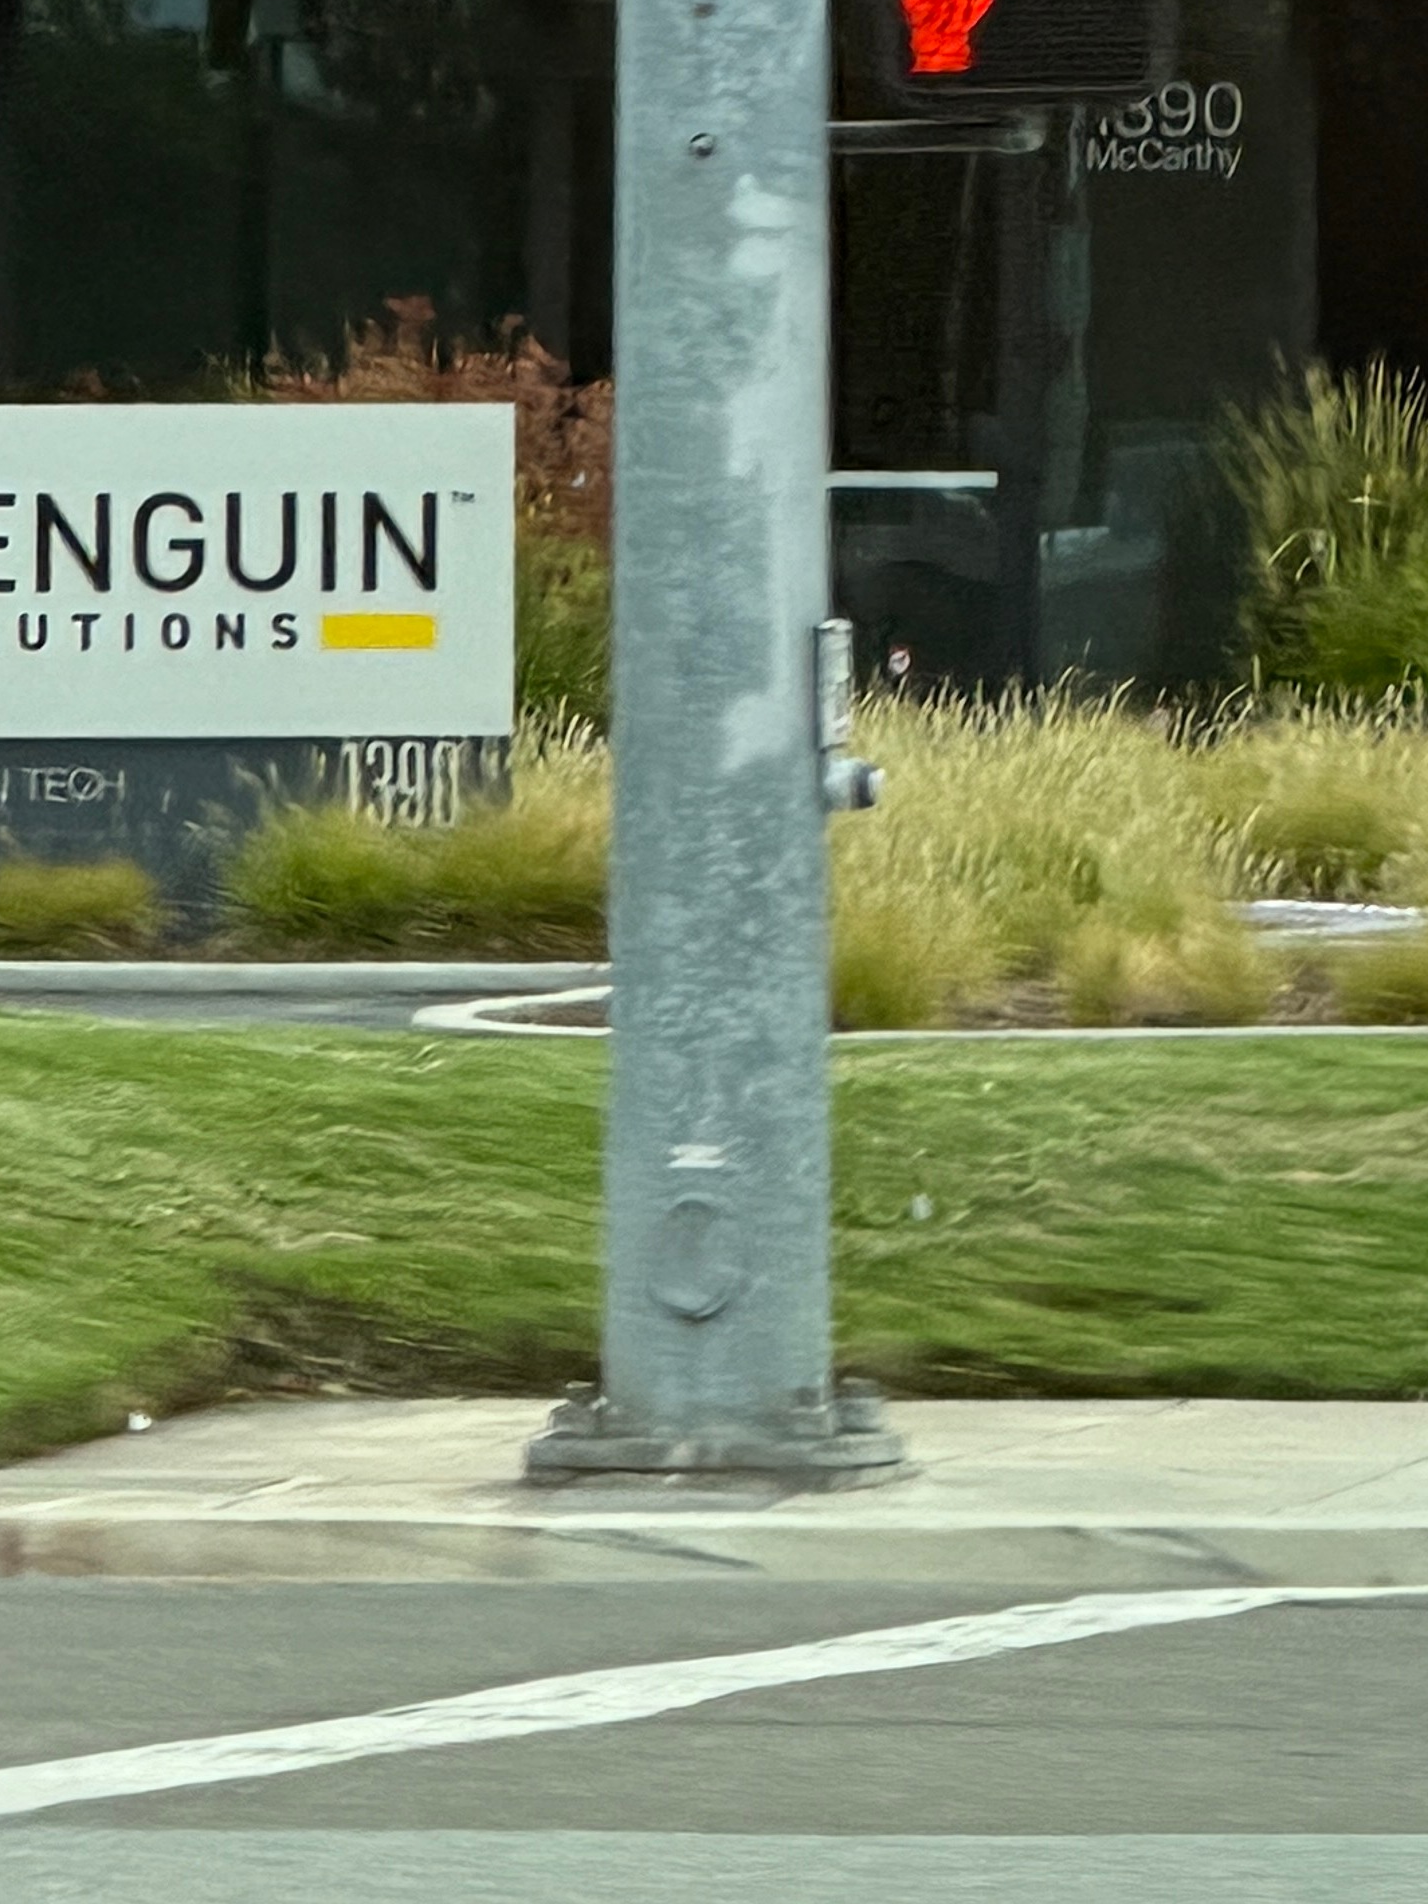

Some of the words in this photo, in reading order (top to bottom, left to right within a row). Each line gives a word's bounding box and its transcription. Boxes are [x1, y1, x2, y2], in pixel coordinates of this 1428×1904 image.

[1098, 81, 1243, 138] 390
[1086, 138, 1243, 180] McCarthy
[21, 766, 126, 802] TECH
[341, 739, 461, 828] 1390
